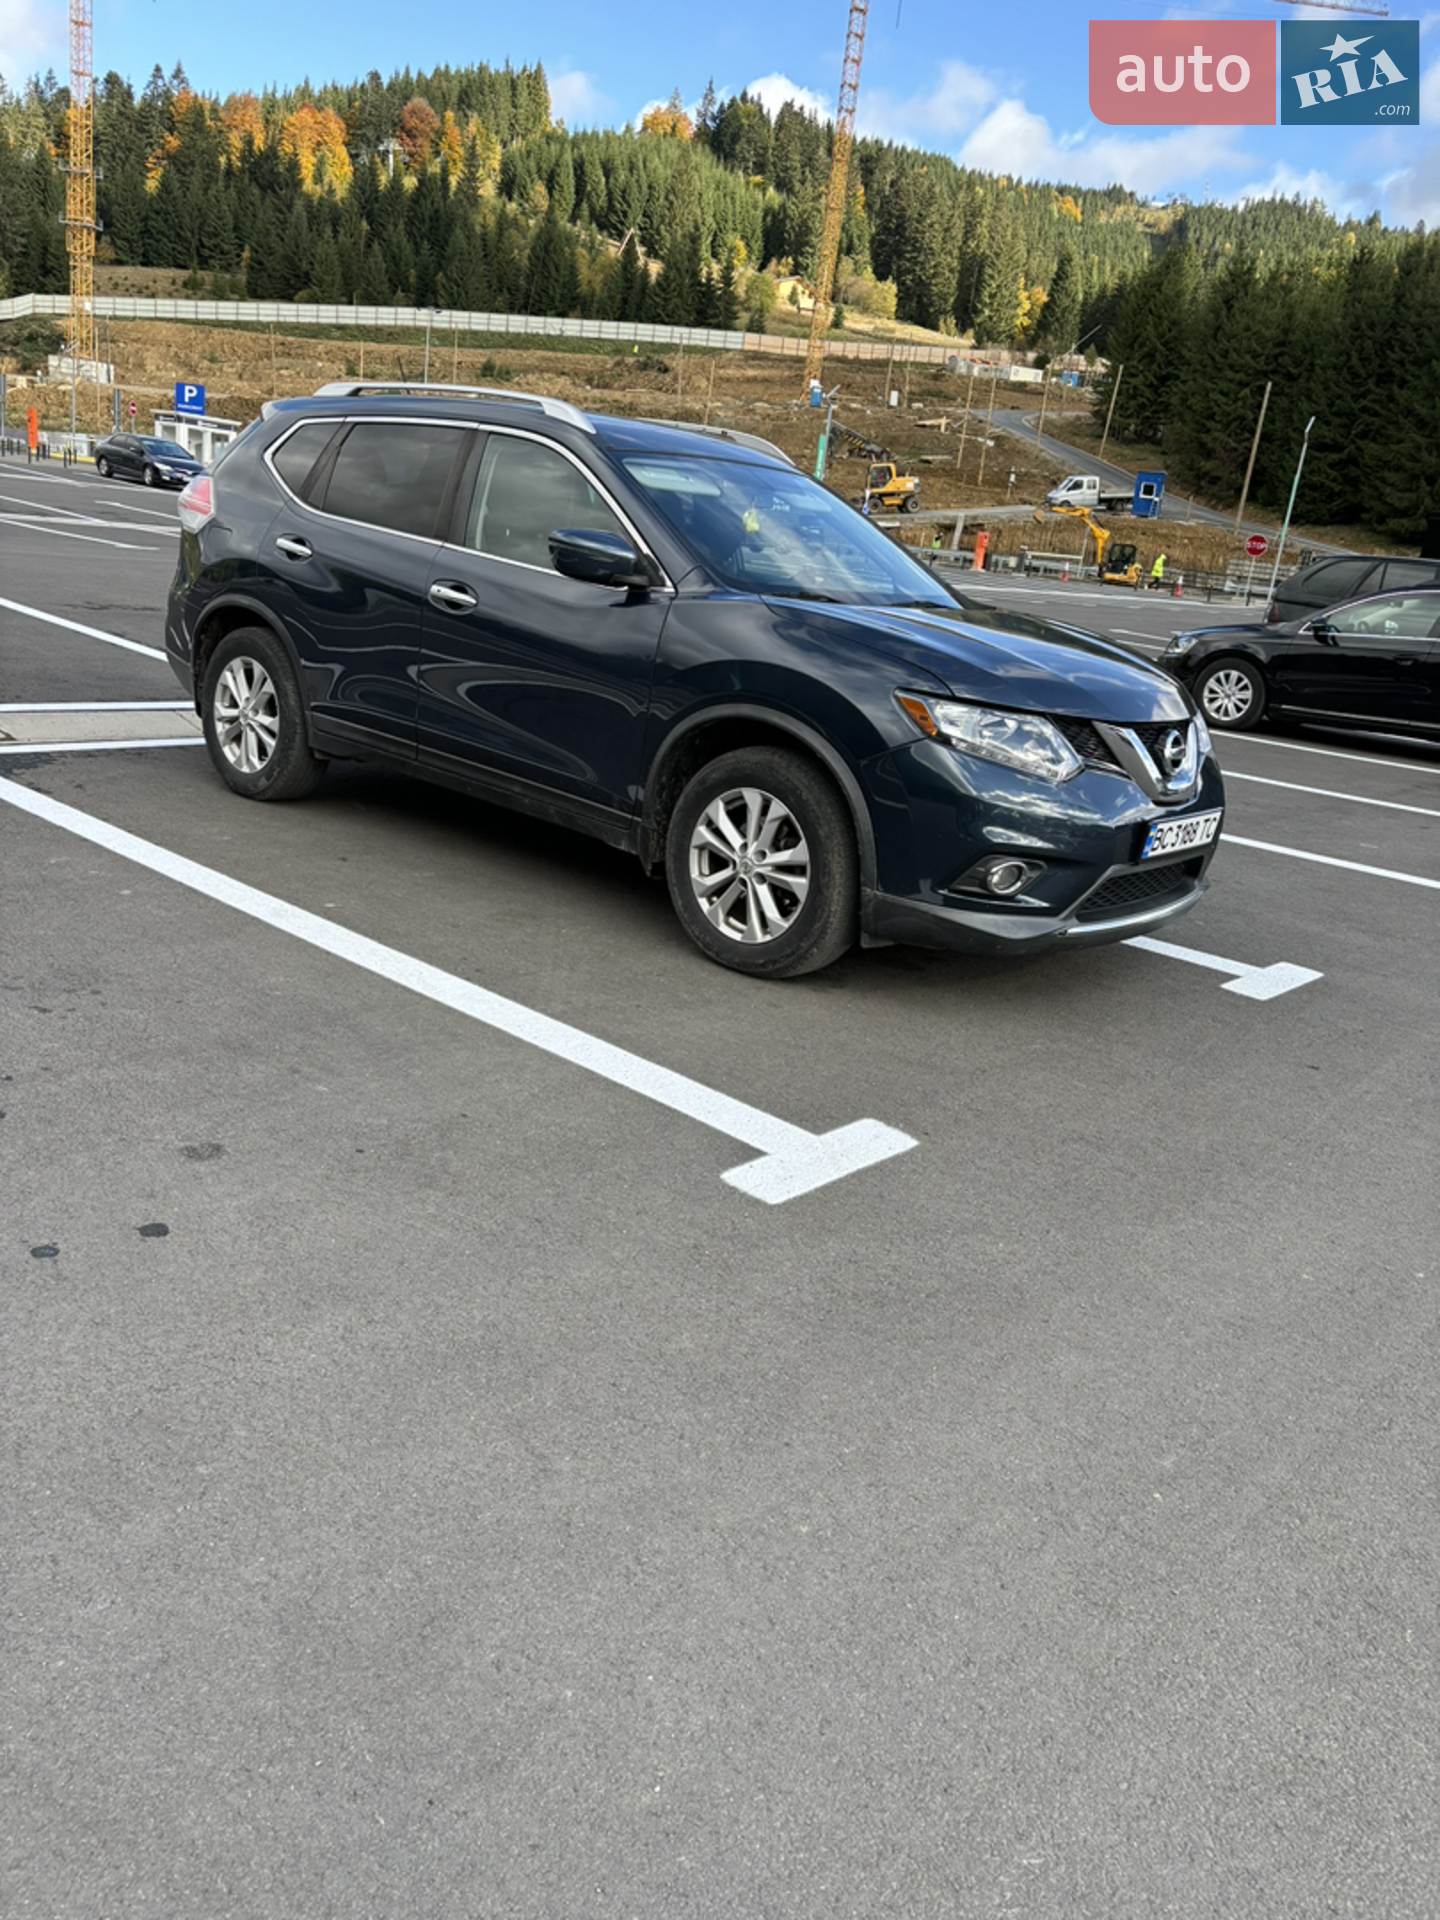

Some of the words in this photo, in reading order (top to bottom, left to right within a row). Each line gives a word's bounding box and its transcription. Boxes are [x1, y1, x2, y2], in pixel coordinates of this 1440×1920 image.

[184, 385, 198, 403] P
[1245, 541, 1267, 551] STOP
[1151, 826, 1174, 853] BC
